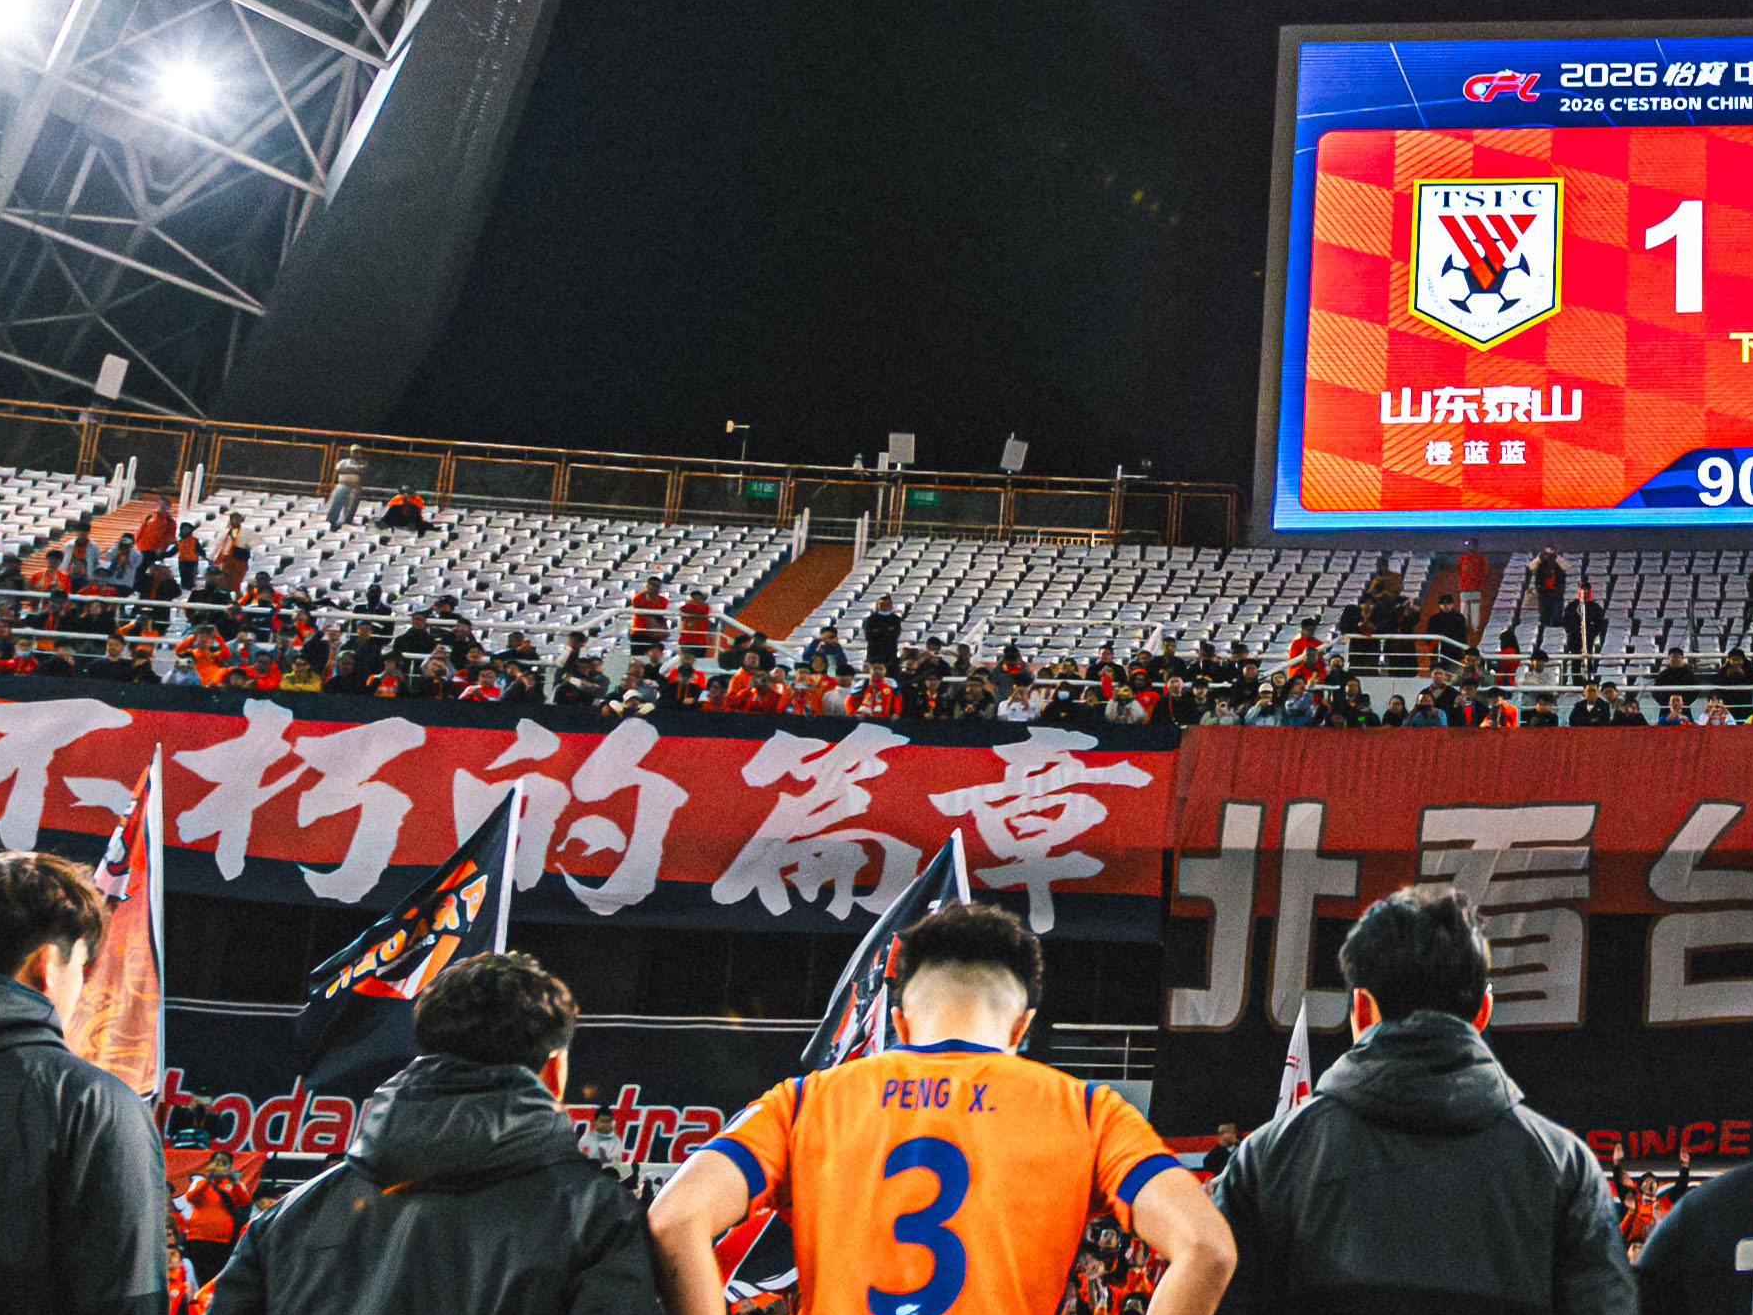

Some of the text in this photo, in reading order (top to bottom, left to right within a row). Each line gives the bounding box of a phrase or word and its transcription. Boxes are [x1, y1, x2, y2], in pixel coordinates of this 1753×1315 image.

[1560, 62, 1658, 87] 2026
[1560, 98, 1604, 112] 2026
[1609, 97, 1701, 111] C'ESTBON
[1434, 189, 1543, 208] TSFC
[1644, 199, 1703, 313] 1
[1380, 385, 1582, 424] 山东泰山
[162, 1068, 378, 1154] toda
[881, 1076, 998, 1114] PENG X.
[1586, 1120, 1752, 1161] SINCE
